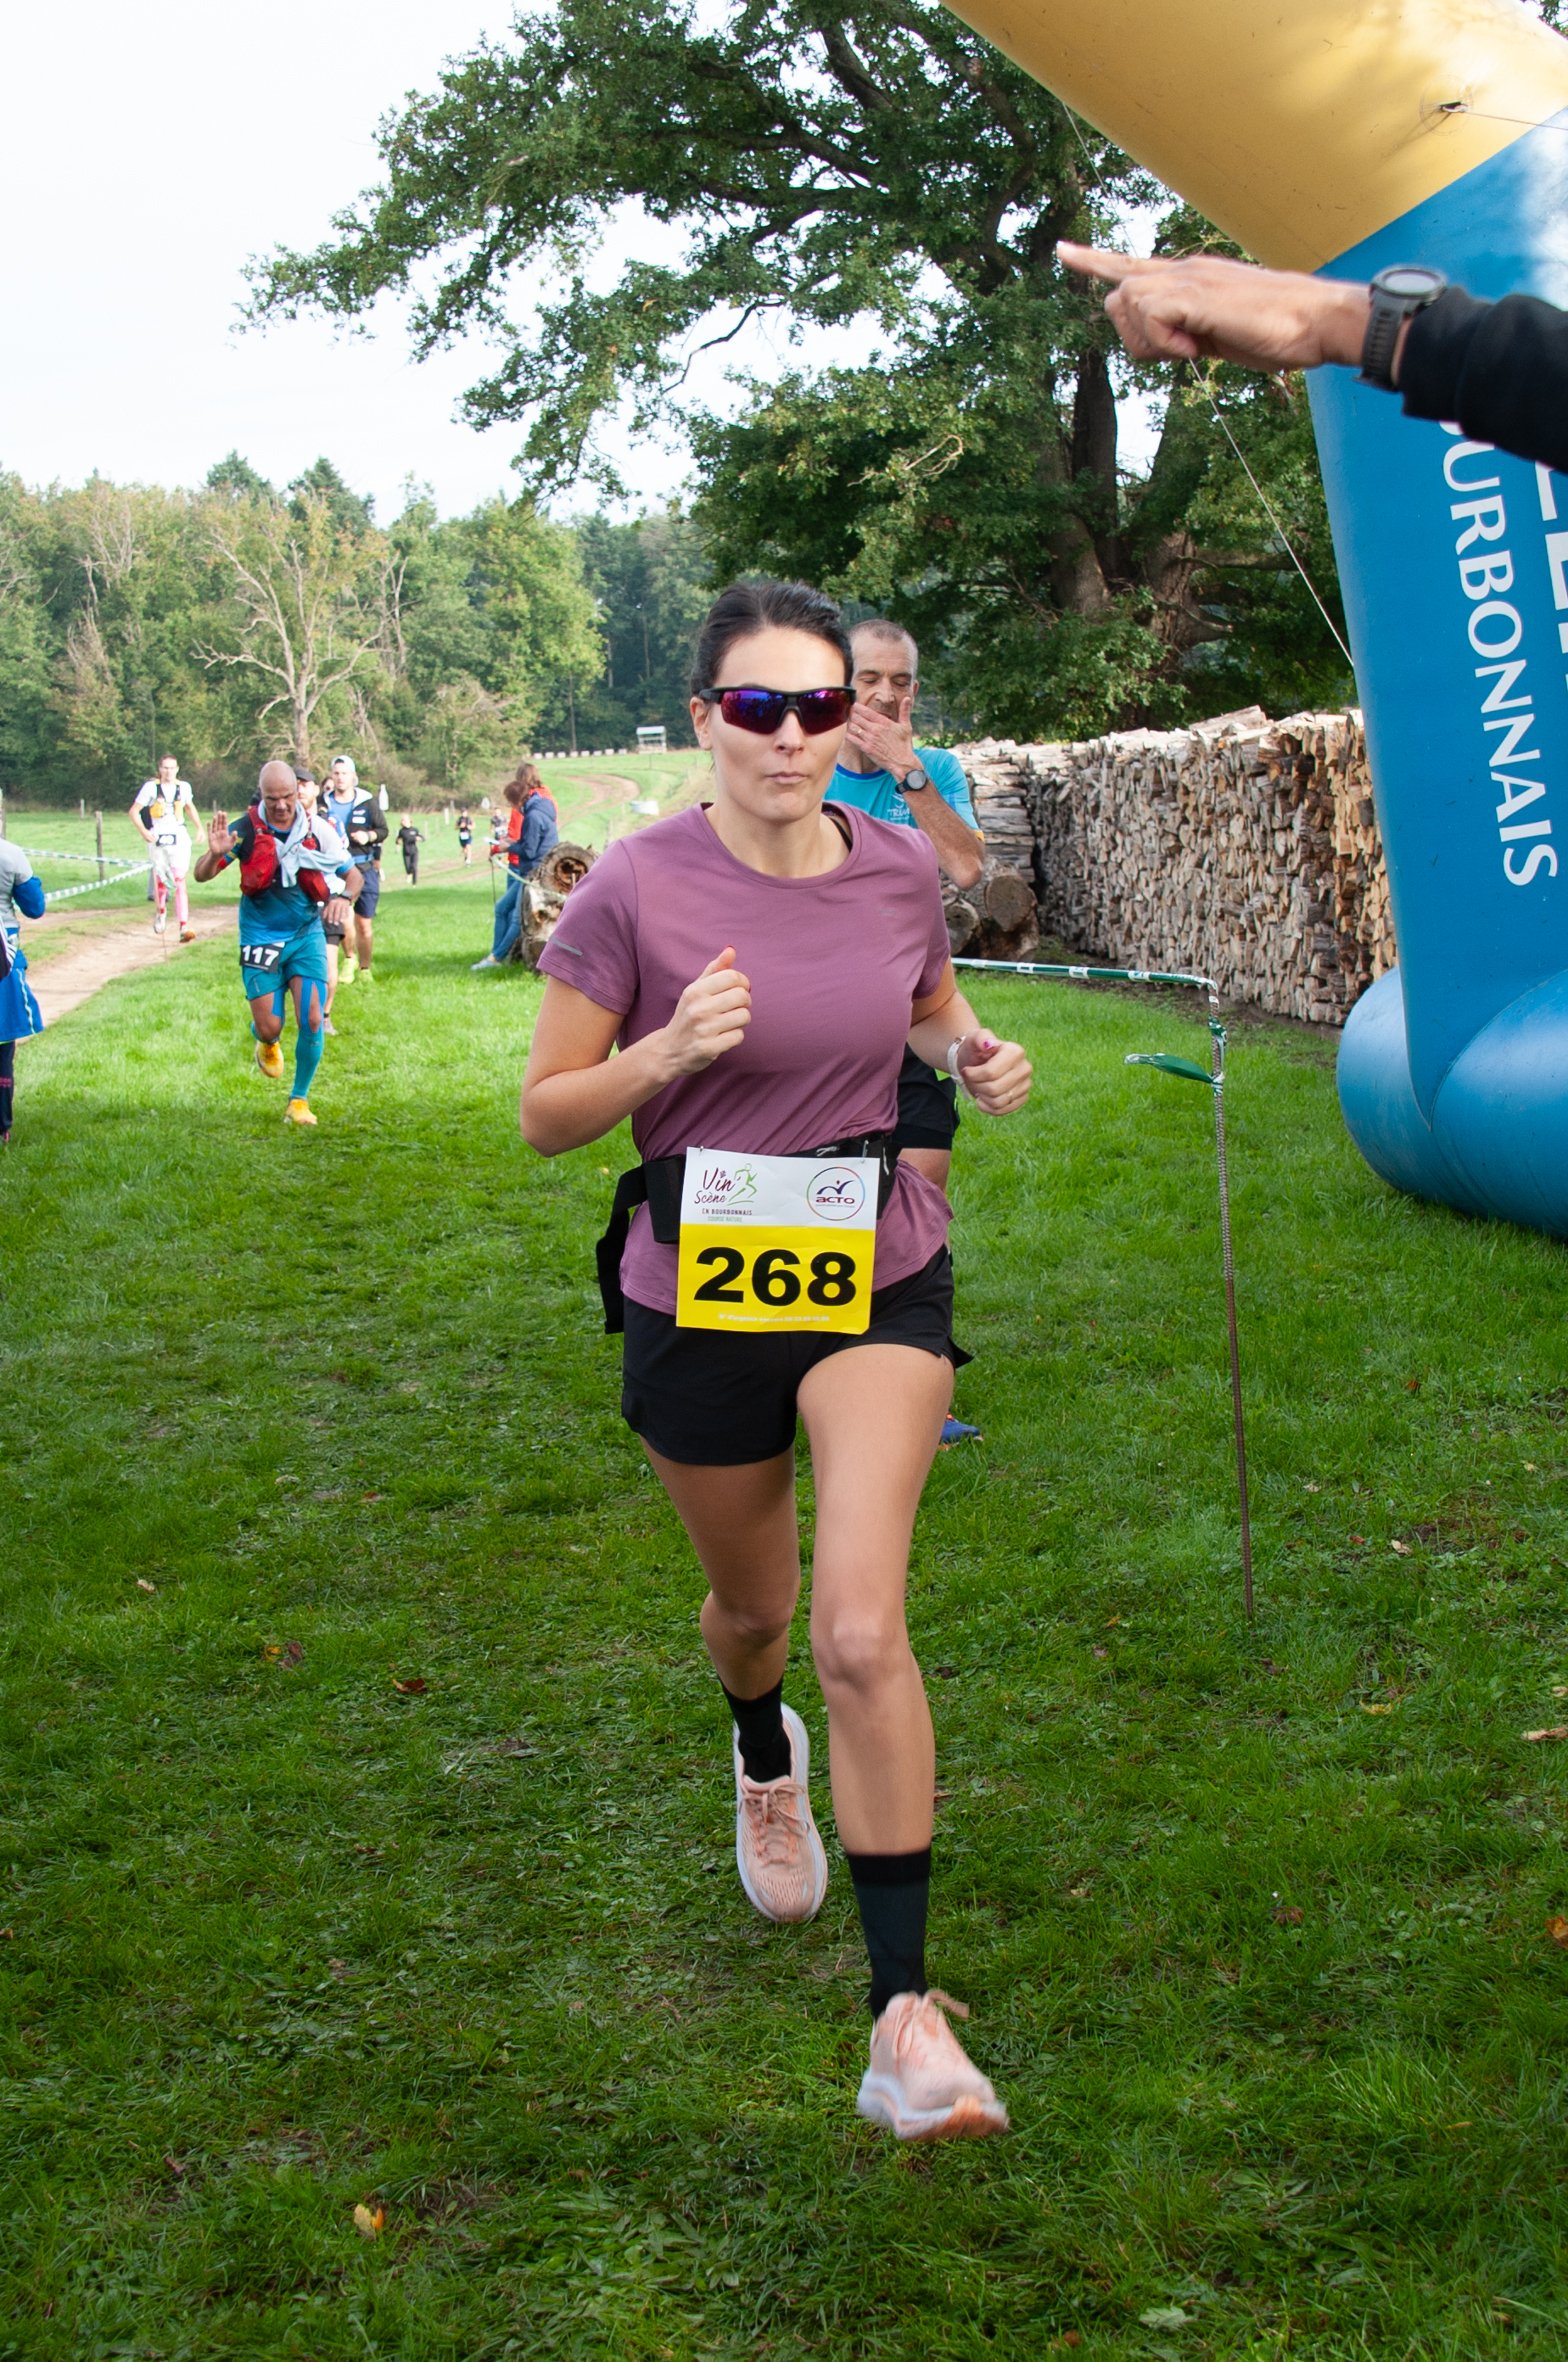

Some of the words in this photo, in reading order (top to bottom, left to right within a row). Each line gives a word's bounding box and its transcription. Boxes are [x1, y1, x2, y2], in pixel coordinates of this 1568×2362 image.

[1439, 421, 1558, 886] URBONNAIS
[243, 945, 280, 966] 117
[694, 1246, 856, 1306] 268
